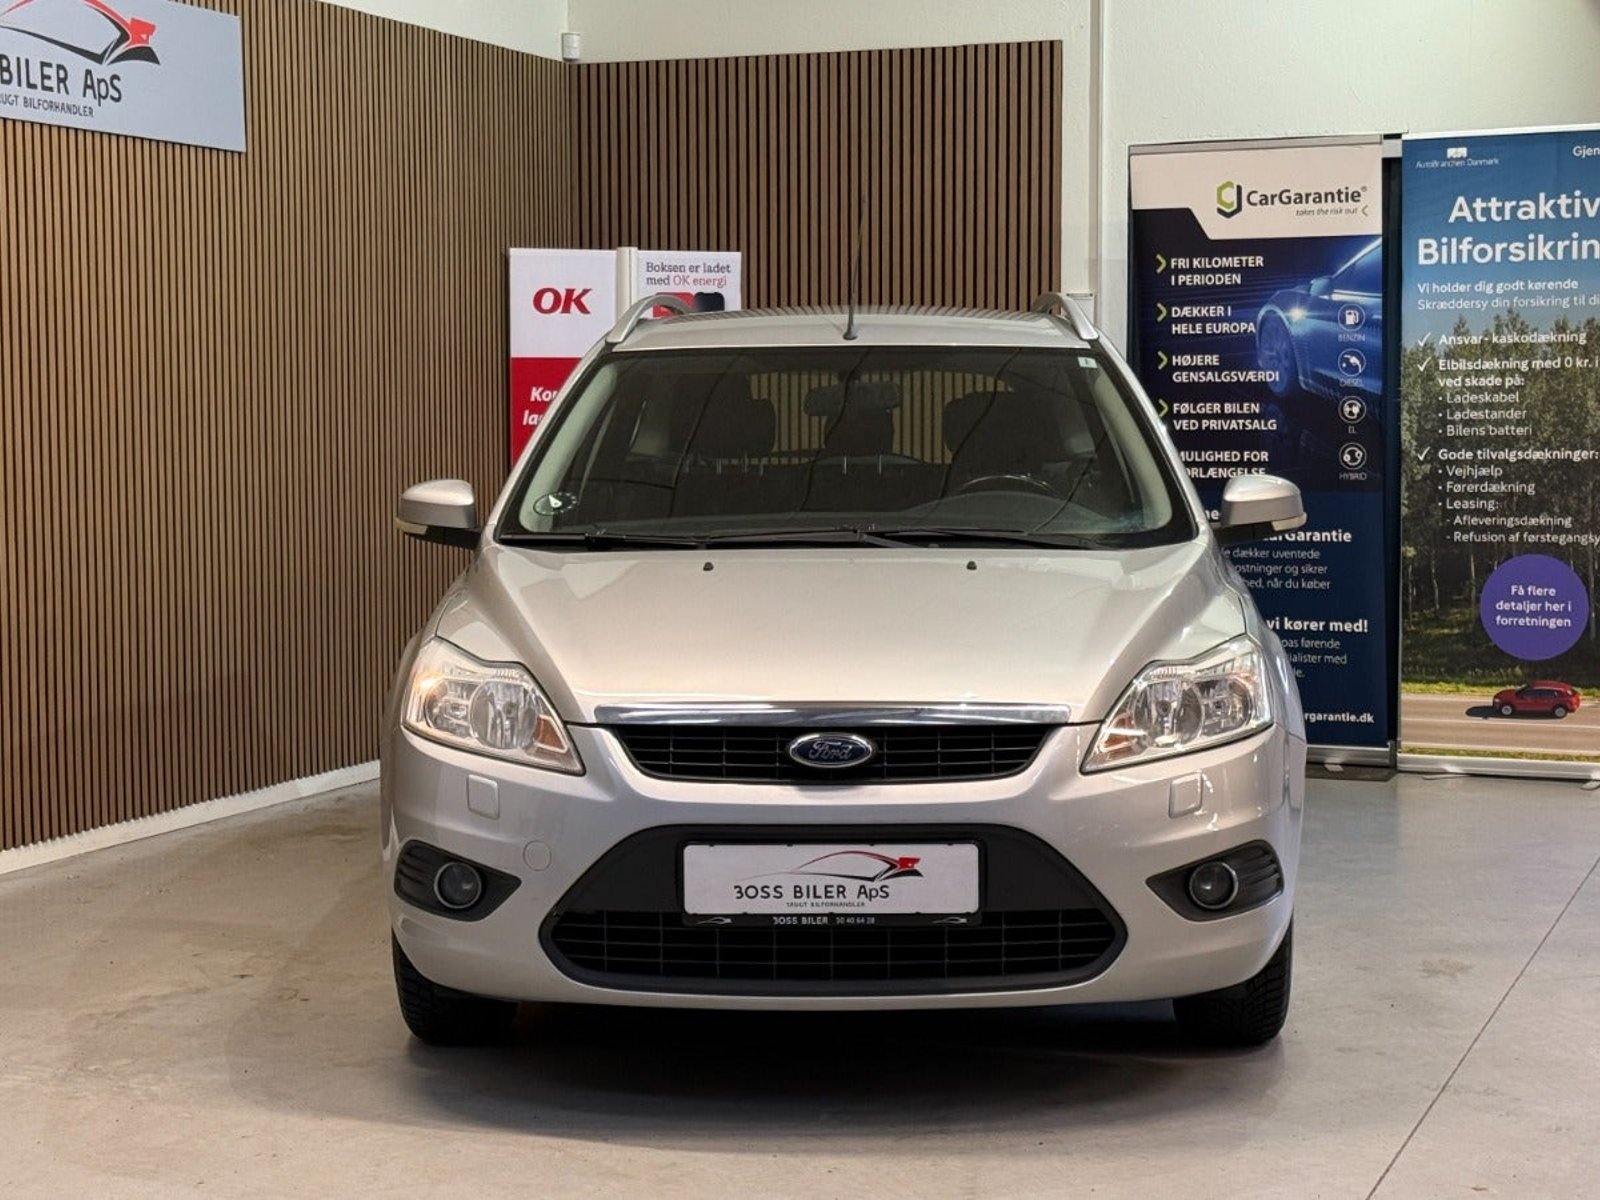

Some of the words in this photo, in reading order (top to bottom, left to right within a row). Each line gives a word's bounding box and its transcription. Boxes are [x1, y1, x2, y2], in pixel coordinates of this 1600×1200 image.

[0, 54, 69, 95] BILER
[83, 68, 122, 107] ApS
[0, 92, 19, 106] UGT
[23, 96, 94, 117] BILFORHANDLER
[1448, 189, 1600, 223] Attraktiv
[1418, 232, 1600, 265] Bilforsikrin
[646, 262, 686, 273] Boksen
[689, 264, 701, 273] er
[703, 262, 731, 274] ladet
[1171, 258, 1190, 269] FRI
[1193, 256, 1264, 268] KILOMETER
[646, 275, 670, 286] med
[673, 275, 690, 286] OK
[692, 275, 727, 289] energi
[1178, 274, 1242, 285] PERIODEN
[1417, 283, 1430, 294] Vi
[1432, 281, 1472, 293] holder
[1474, 281, 1494, 294] dig
[1496, 279, 1525, 293] godt
[1528, 279, 1578, 290] kørende
[533, 288, 592, 314] OK
[1418, 297, 1488, 311] Skræddersy
[1490, 297, 1510, 308] din
[1513, 294, 1570, 308] forsikring
[1573, 294, 1586, 306] til
[1171, 306, 1224, 318] DÆKKER
[1172, 324, 1203, 335] HELE
[1205, 322, 1256, 334] EUROPA
[1492, 331, 1587, 345] kaskodækning
[1172, 354, 1220, 367] HØJERE
[1438, 356, 1529, 371] Elbilsdækning
[1532, 356, 1561, 369] med
[1564, 356, 1573, 368] 0
[1576, 356, 1592, 368] kr.
[1172, 371, 1280, 383] GENSALGSVÆRDI
[1439, 376, 1462, 388] ved
[1464, 375, 1502, 387] skade
[1505, 374, 1525, 389] på:
[1447, 391, 1519, 404] Ladeskabel
[1173, 402, 1221, 415] FØLGER
[1225, 402, 1260, 414] BILEN
[1447, 407, 1527, 420] Ladestander
[522, 410, 543, 425] la
[1173, 420, 1199, 431] VED
[1202, 419, 1278, 431] PRIVATSALG
[1447, 424, 1486, 437] Bilens
[1489, 424, 1532, 437] batteri
[1244, 450, 1269, 462] FOR
[1438, 448, 1474, 460] Gode
[1446, 464, 1503, 479] Vejhjælp
[1446, 481, 1536, 495] Førerdækning
[1453, 514, 1573, 528] Afleveringsdækning
[1453, 531, 1505, 543] Refusion
[1508, 531, 1520, 542] af
[1233, 547, 1270, 559] dækker
[1272, 547, 1321, 559] uventede
[1235, 563, 1282, 575] ostninger
[1284, 566, 1299, 576] og
[1301, 564, 1329, 575] sikrer
[1266, 578, 1282, 588] når
[1285, 578, 1299, 589] du
[1301, 579, 1332, 590] køber
[1511, 584, 1525, 596] Få
[1527, 585, 1556, 597] flere
[1496, 601, 1542, 613] detaljer
[1545, 601, 1566, 612] her
[1284, 617, 1325, 631] kører
[1329, 618, 1368, 632] med!
[1496, 615, 1571, 628] forretningen
[1301, 637, 1341, 649] førende
[1289, 652, 1322, 663] ialister
[1324, 653, 1347, 664] med
[1304, 712, 1375, 723] rgarantie.dk
[808, 739, 853, 759] Ford
[793, 885, 847, 899] BILER
[857, 884, 890, 901] ApS
[801, 916, 829, 925] BILER
